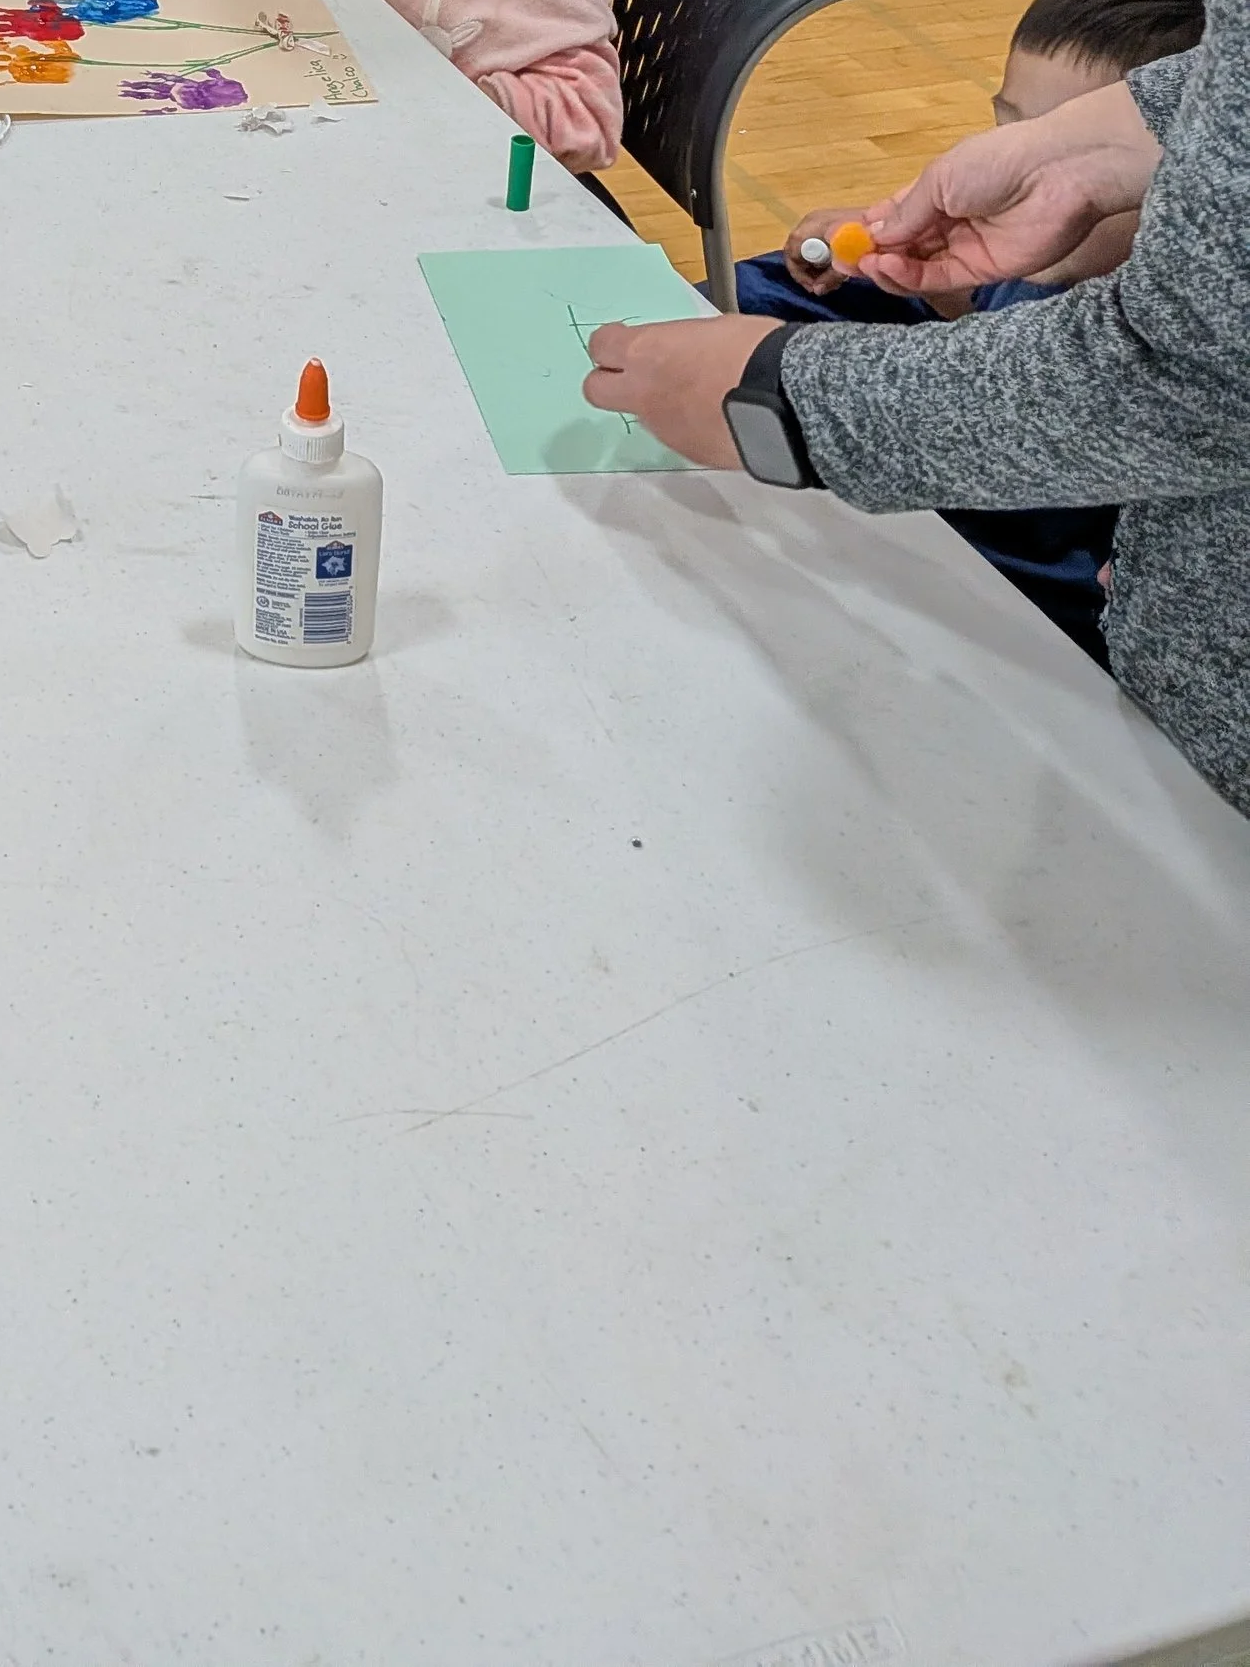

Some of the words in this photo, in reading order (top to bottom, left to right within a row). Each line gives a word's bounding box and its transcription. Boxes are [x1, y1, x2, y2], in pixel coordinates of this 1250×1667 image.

[303, 59, 348, 100] Angelica
[342, 66, 368, 98] Chalco
[287, 521, 320, 530] School
[320, 522, 343, 530] Glue
